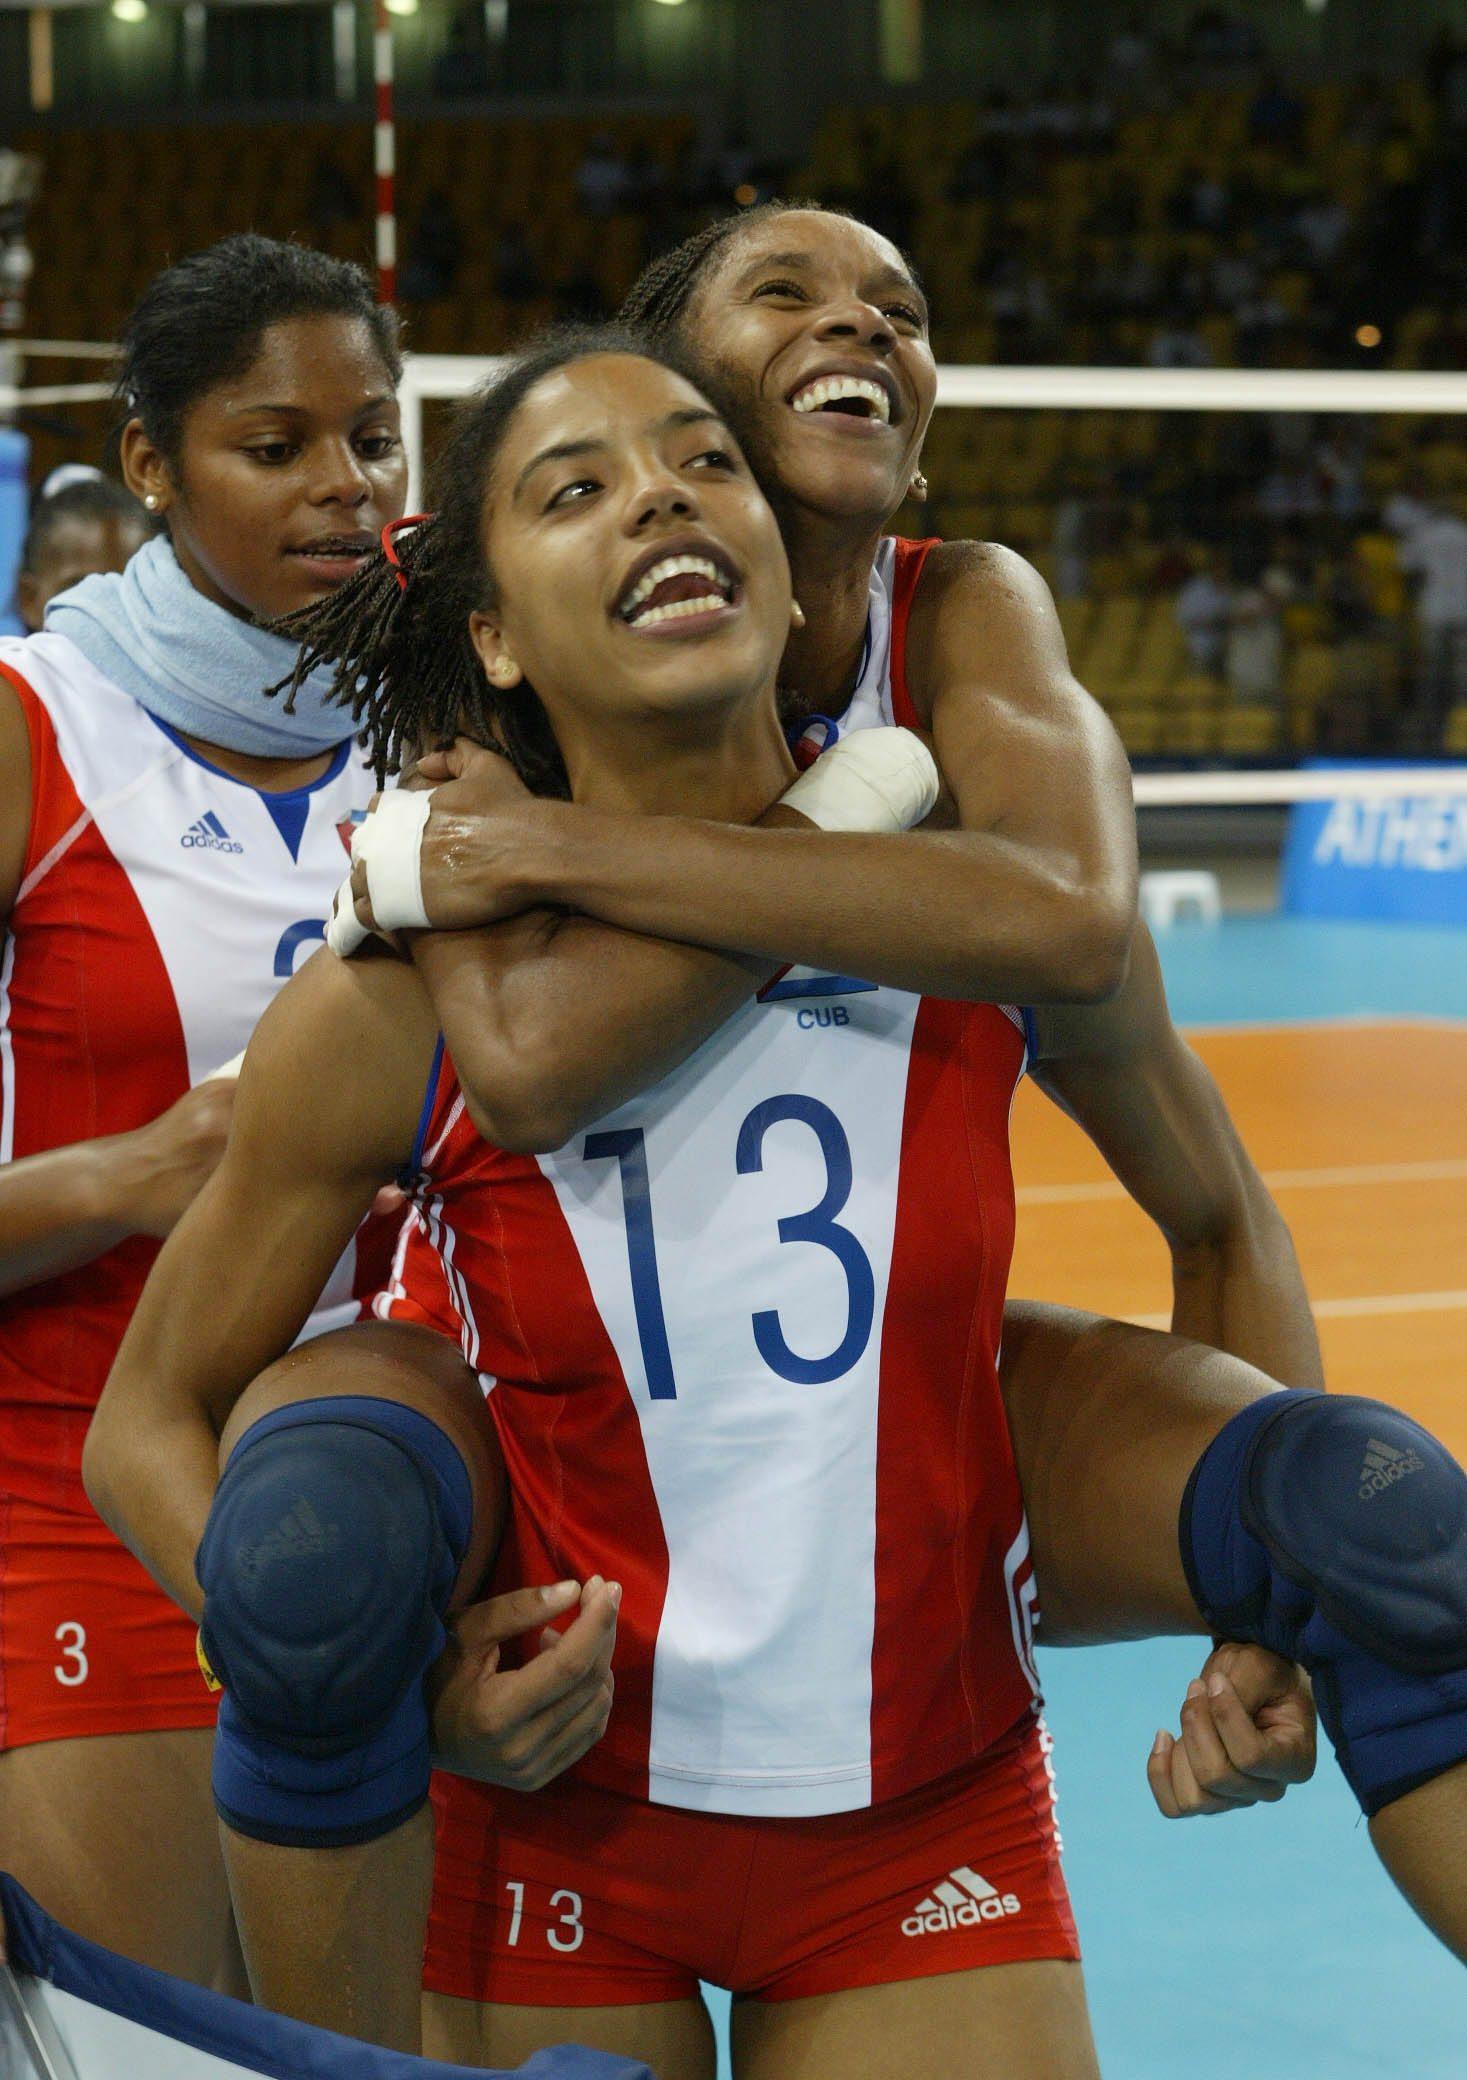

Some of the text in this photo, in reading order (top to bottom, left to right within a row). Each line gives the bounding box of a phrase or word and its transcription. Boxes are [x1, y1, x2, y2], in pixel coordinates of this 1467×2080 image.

[180, 832, 244, 854] adidas
[797, 1006, 850, 1029] CUB
[583, 1093, 875, 1400] 13
[1358, 1456, 1424, 1499] adidas
[54, 1621, 88, 1686] 3
[505, 1881, 584, 1952] 13
[900, 1893, 1021, 1937] adidas
